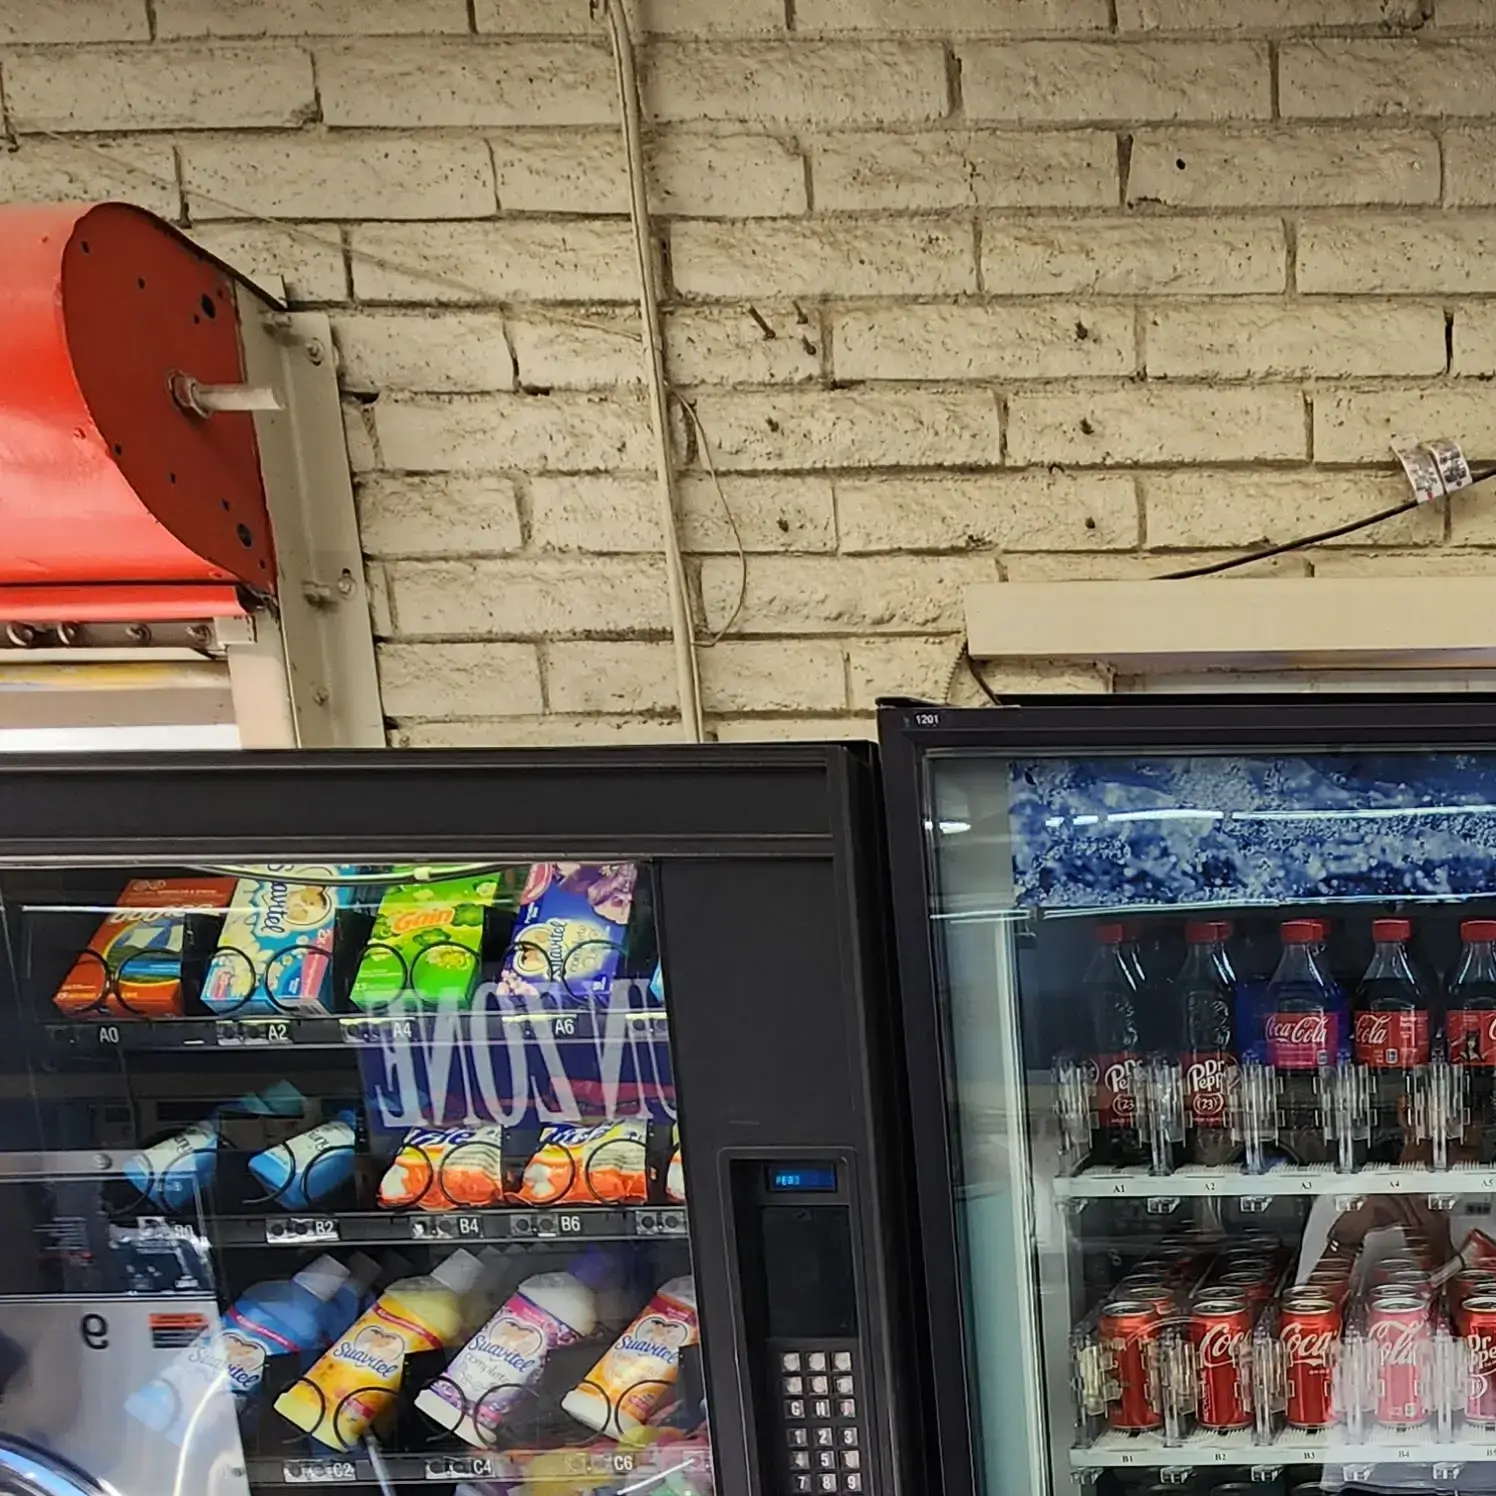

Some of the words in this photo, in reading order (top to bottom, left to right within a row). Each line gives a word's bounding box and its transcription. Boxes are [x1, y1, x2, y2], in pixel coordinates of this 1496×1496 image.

[915, 713, 939, 725] 1201
[394, 908, 454, 934] Gain
[268, 1025, 288, 1040] A2
[393, 1023, 412, 1037] A4
[555, 1019, 574, 1035] A6
[1265, 1014, 1327, 1044] Coca-Cola
[100, 1028, 119, 1043] A0
[1206, 1061, 1224, 1075] Dr
[1112, 1184, 1125, 1193] A1
[1204, 1182, 1216, 1191] A2
[1300, 1181, 1312, 1190] A3
[1389, 1180, 1400, 1188] A4
[1481, 1179, 1494, 1187] A5
[316, 1221, 334, 1234] B2
[460, 1218, 479, 1232] B4
[561, 1216, 580, 1231] B6
[467, 1334, 535, 1373] Suavitel
[615, 1335, 678, 1364] Suavitel
[333, 1342, 399, 1378] Suavitel
[1122, 1455, 1134, 1463] B1
[1215, 1453, 1227, 1461] B2
[1304, 1452, 1316, 1460] B3
[1398, 1450, 1410, 1458] B4
[474, 1459, 491, 1474] C4
[615, 1456, 632, 1470] C6
